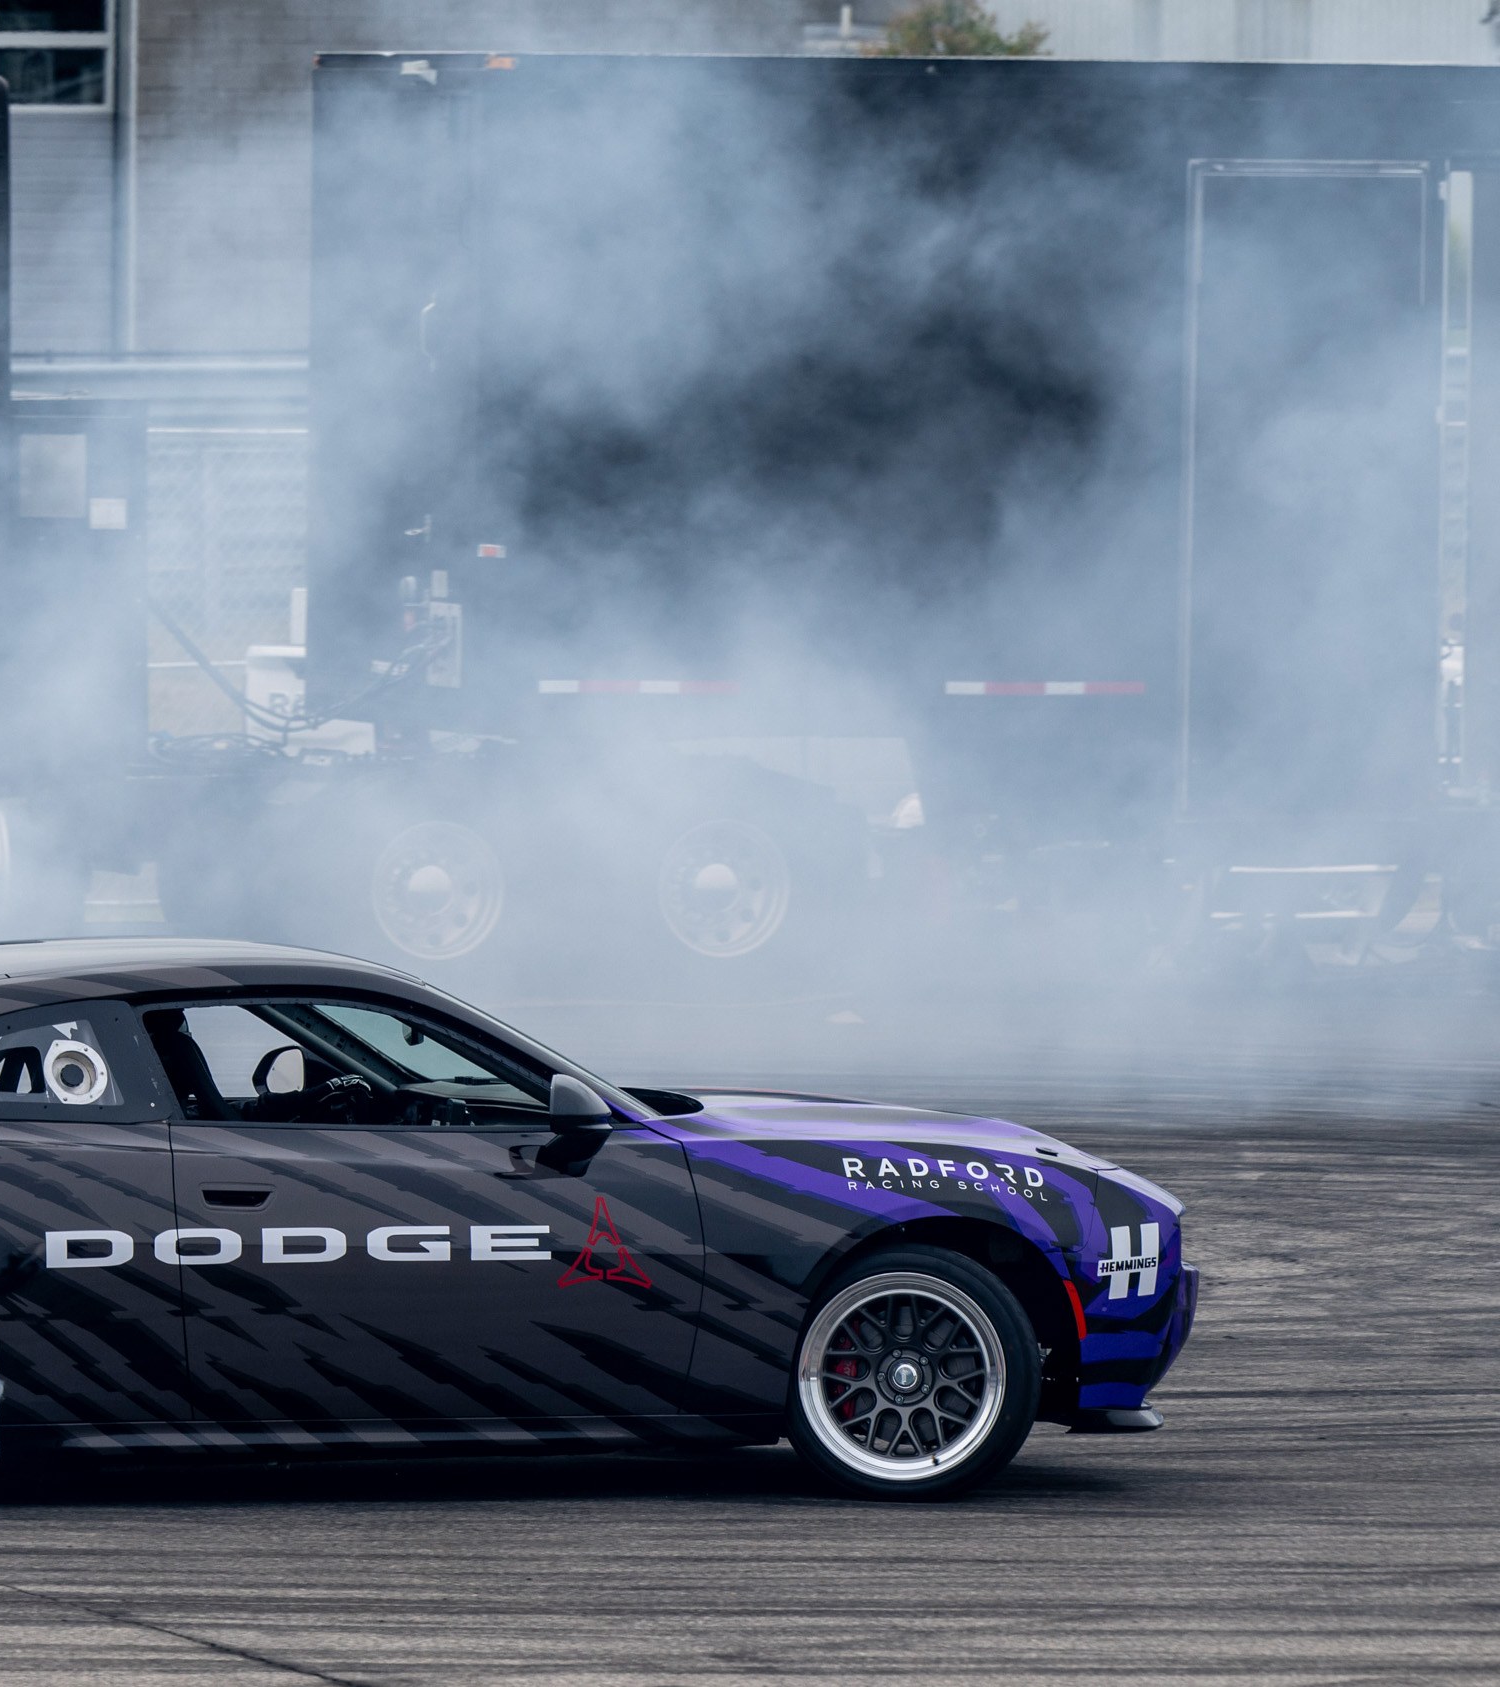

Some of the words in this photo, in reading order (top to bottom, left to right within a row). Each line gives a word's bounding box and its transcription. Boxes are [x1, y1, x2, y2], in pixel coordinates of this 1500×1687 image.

[841, 1157, 1045, 1188] RADFORD
[847, 1179, 941, 1191] RACING
[957, 1180, 1049, 1202] SCHOOL
[45, 1225, 552, 1269] DODGE
[1099, 1256, 1157, 1273] HEMMINGS
